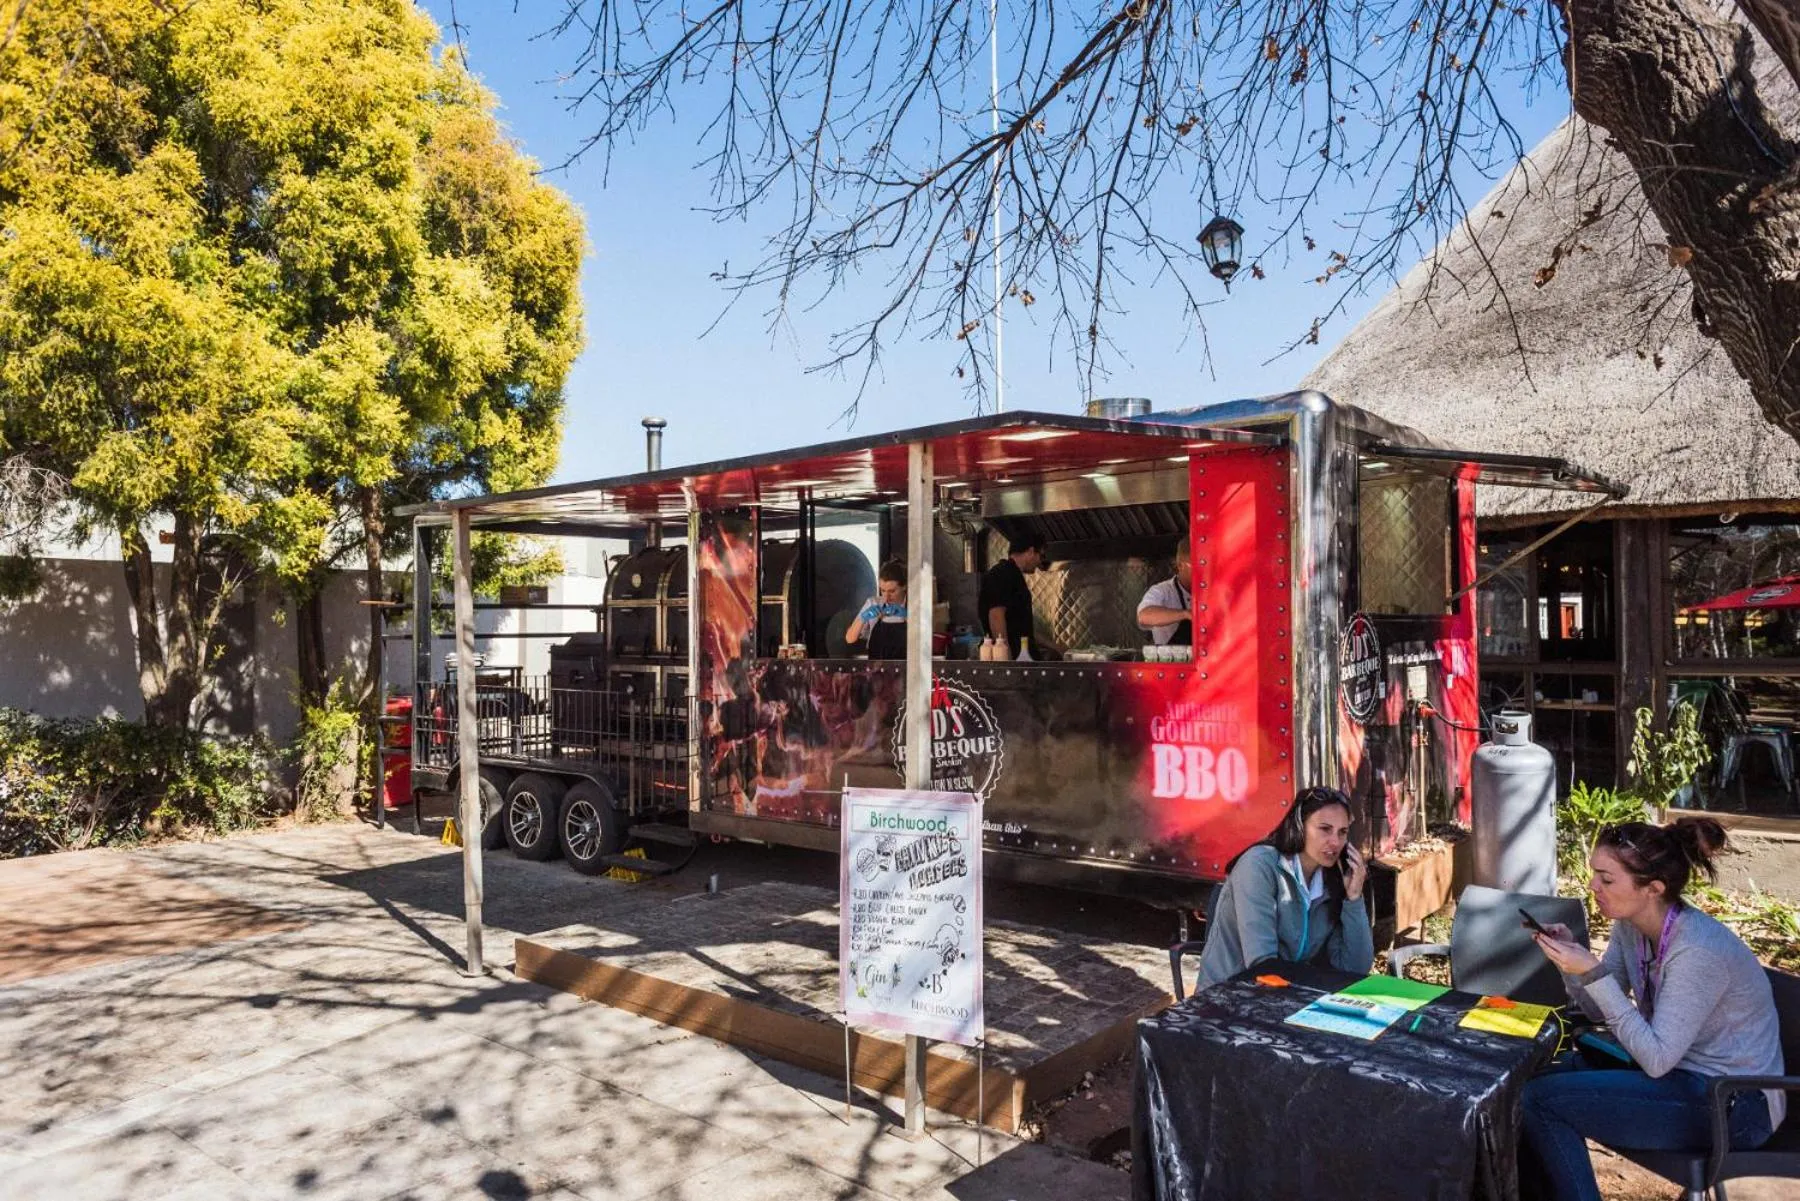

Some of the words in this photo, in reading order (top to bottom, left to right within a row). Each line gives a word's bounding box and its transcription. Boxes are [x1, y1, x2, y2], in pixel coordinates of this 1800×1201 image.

[932, 705, 965, 740] D'S
[953, 697, 984, 728] QUALITY
[897, 735, 997, 762] BBEQUE
[1151, 743, 1249, 804] BBQ
[870, 811, 948, 833] Birchwood
[865, 964, 888, 988] Gin
